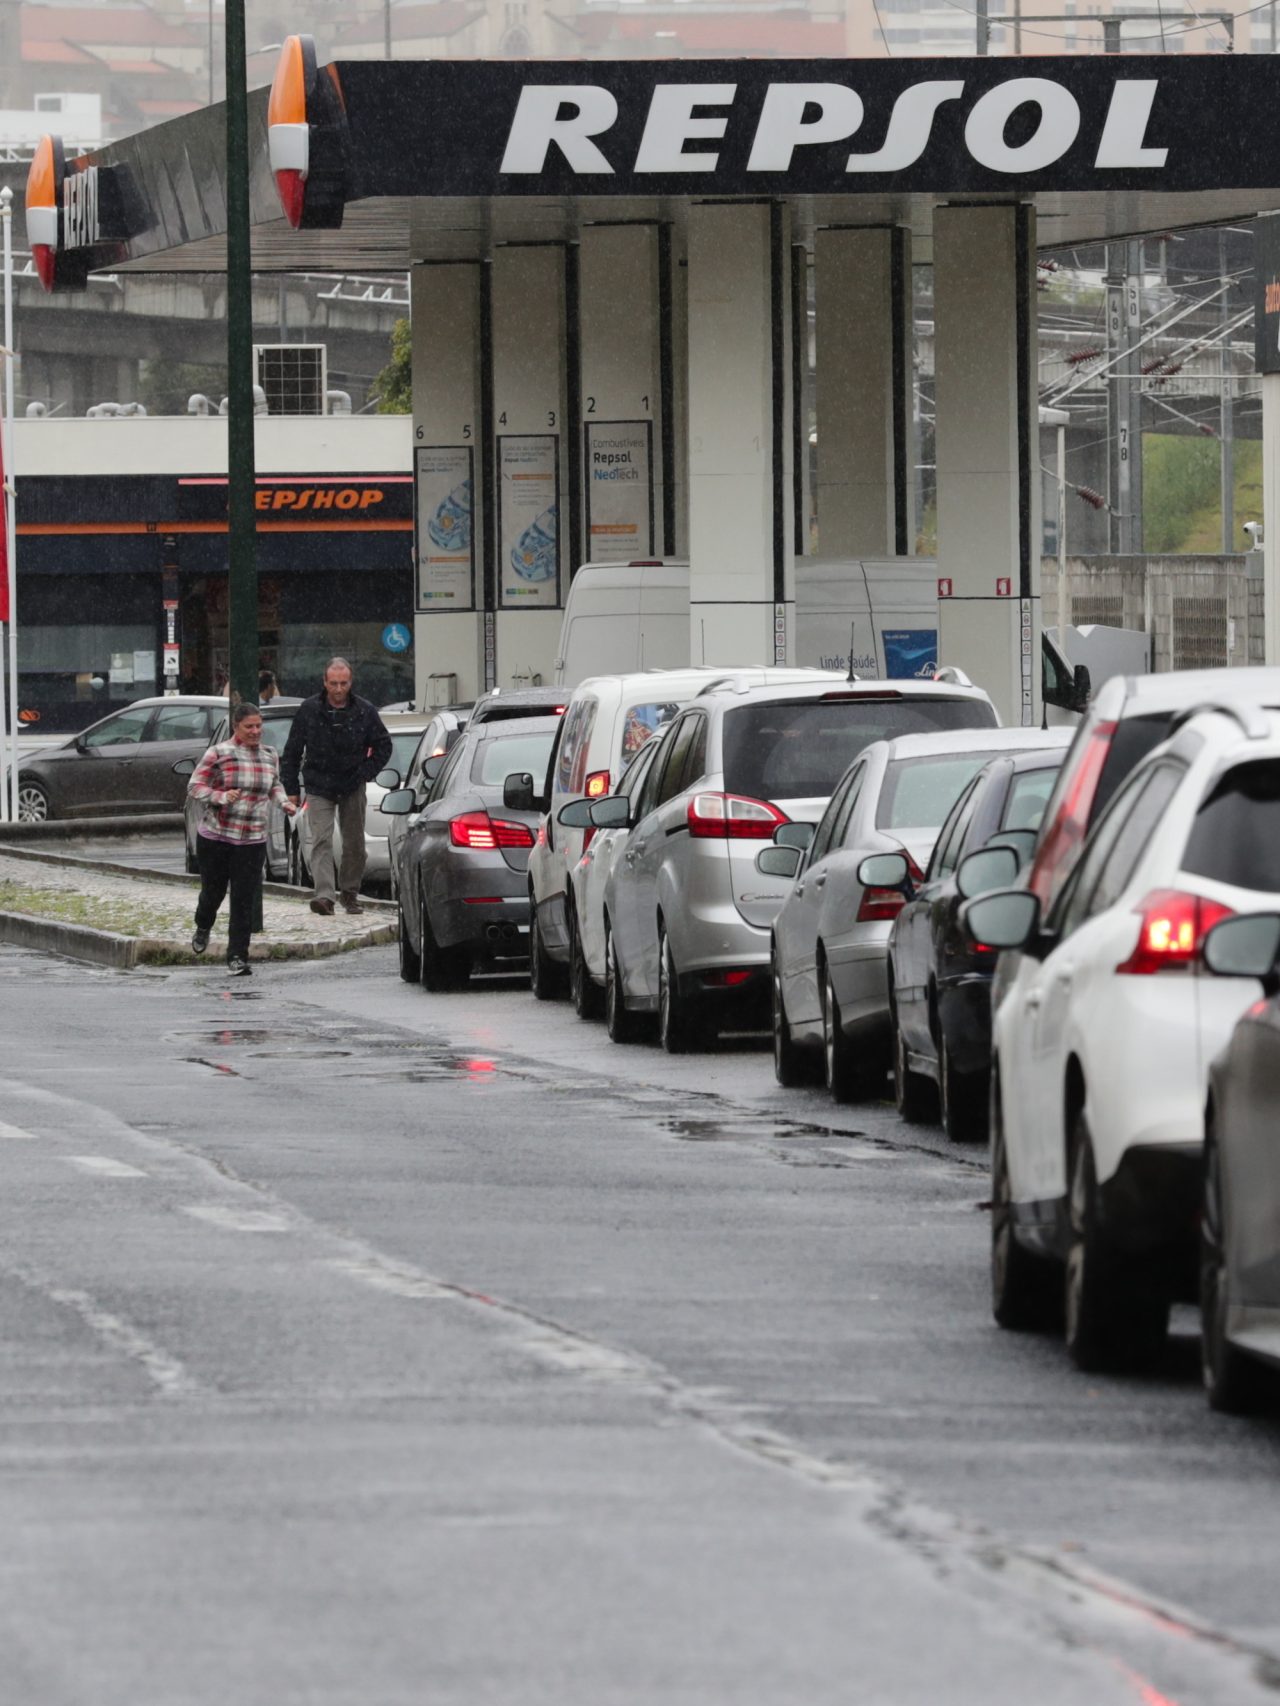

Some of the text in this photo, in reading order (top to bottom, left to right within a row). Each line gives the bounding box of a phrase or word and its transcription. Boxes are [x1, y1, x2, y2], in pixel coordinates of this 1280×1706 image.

[499, 77, 1169, 175] REPSOL
[587, 395, 649, 413] 2 1
[499, 412, 555, 427] 4 3
[416, 425, 471, 439] 6 5
[1120, 428, 1128, 461] 78
[593, 450, 632, 466] Repsol
[594, 467, 639, 480] NeoTech
[227, 489, 384, 510] EPSHOP
[820, 654, 876, 669] Linde Saúde
